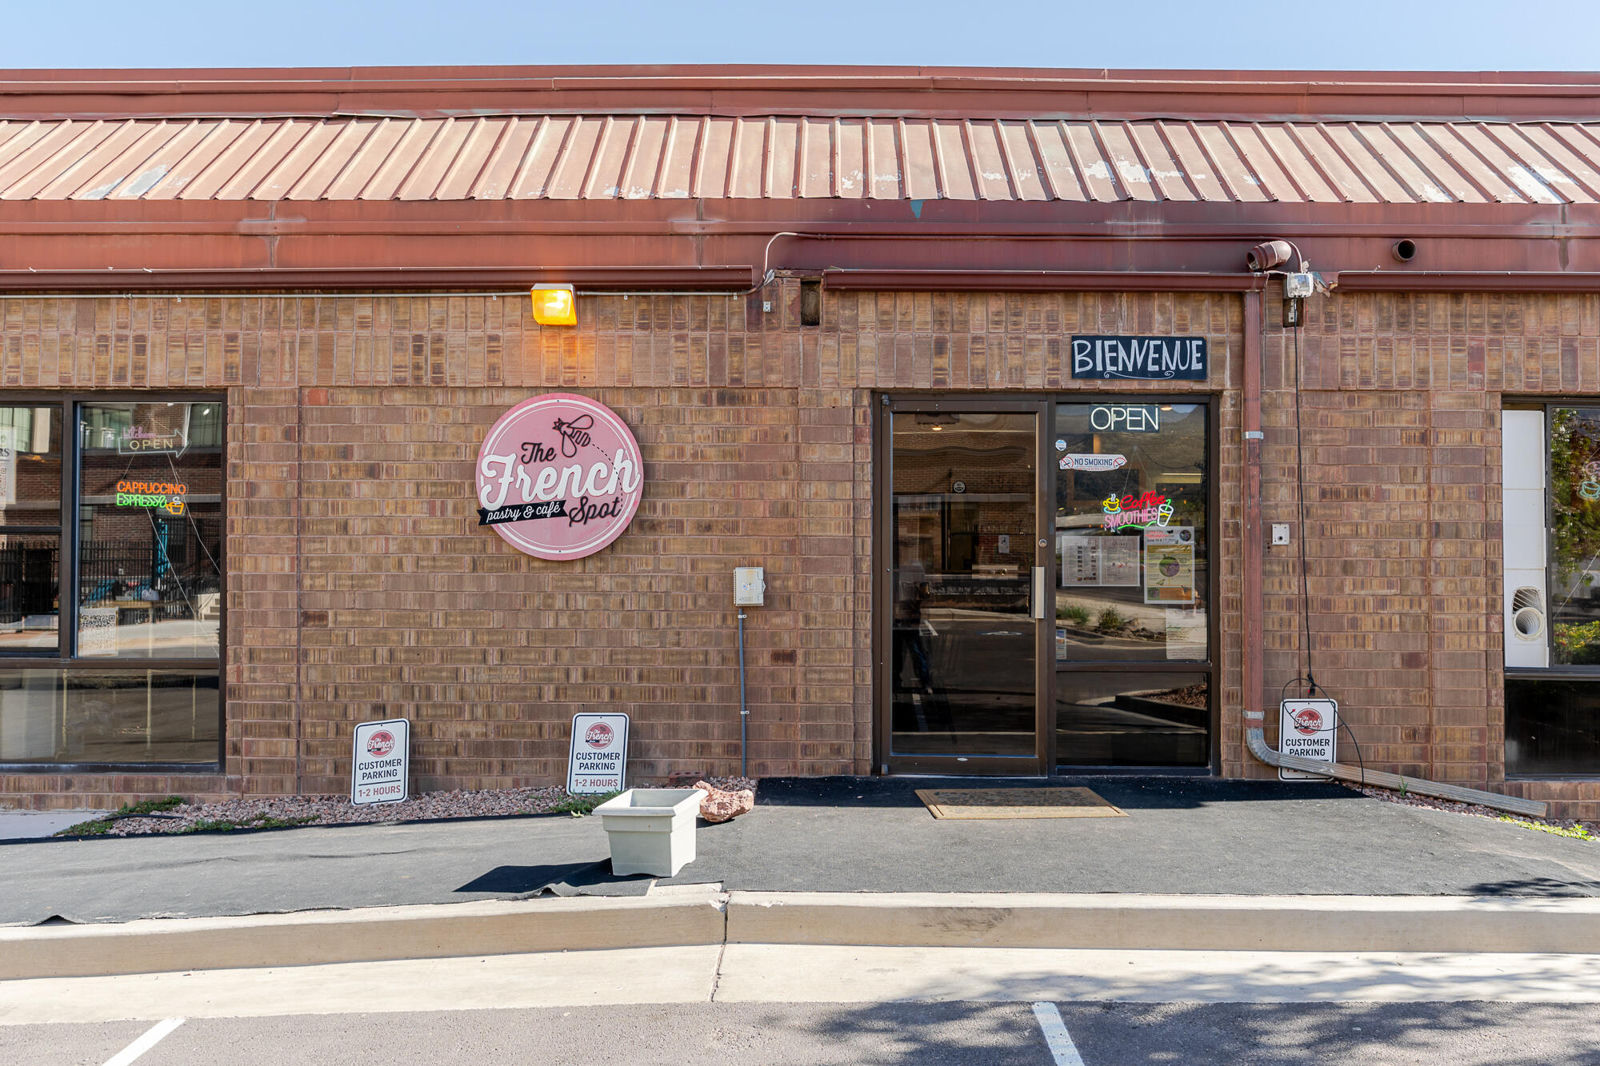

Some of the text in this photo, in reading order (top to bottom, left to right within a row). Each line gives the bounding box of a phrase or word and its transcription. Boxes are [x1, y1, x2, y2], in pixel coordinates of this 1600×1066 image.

[1072, 339, 1203, 373] BIENVENUE
[1090, 407, 1160, 431] OPEN
[129, 438, 174, 450] OPEN
[521, 441, 557, 465] The
[1074, 458, 1113, 466] NO SMOKING
[480, 448, 641, 511] French
[116, 480, 187, 495] CAPPUCCINO
[1120, 490, 1167, 510] Coffee
[486, 501, 561, 523] pastry & café
[568, 496, 622, 528] Spot
[1104, 507, 1158, 529] SMOOTHIES
[1285, 738, 1330, 747] CUSTOMER
[575, 752, 621, 761] CUSTOMER
[1289, 748, 1326, 757] PARKING
[358, 758, 402, 771] CUSTOMER
[579, 762, 616, 771] PARKING
[362, 769, 398, 781] PARKING
[574, 778, 618, 788] 1-2 HOURS
[358, 784, 401, 798] 1-2 HOURS
